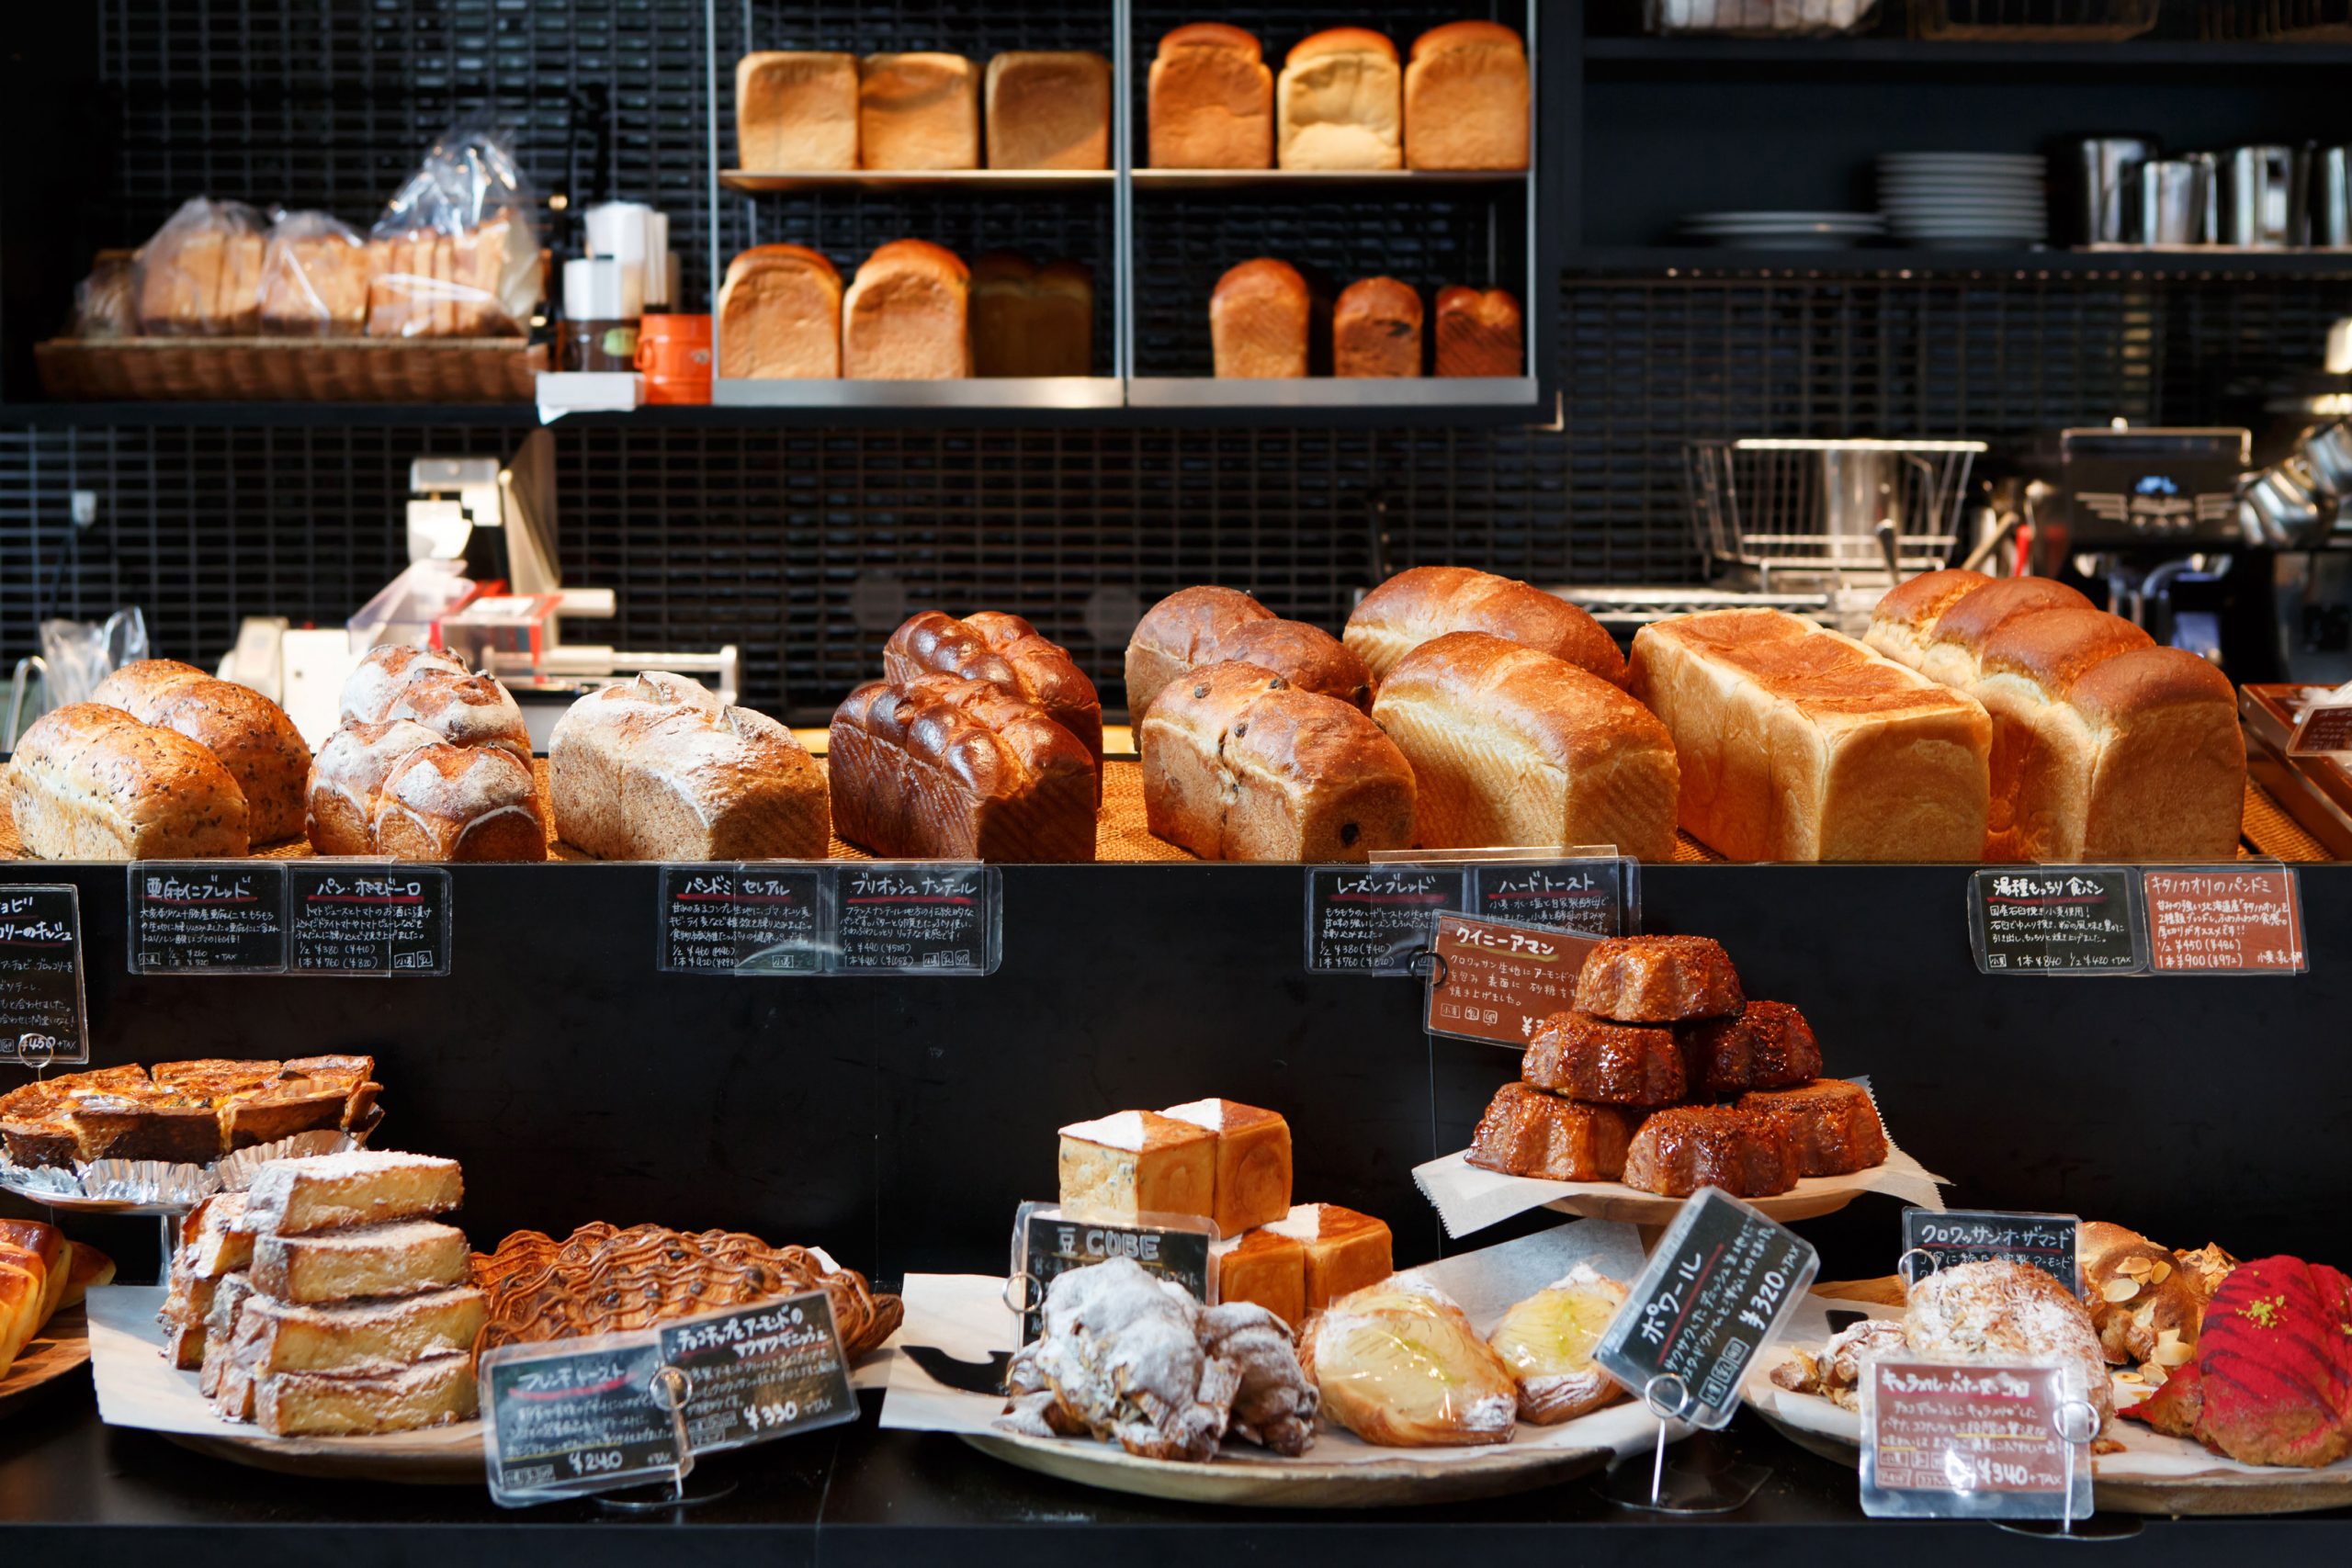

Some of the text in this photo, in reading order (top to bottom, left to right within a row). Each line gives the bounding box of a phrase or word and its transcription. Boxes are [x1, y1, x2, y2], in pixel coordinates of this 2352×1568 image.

[145, 874, 251, 899] 亜麻仁ブレッド
[684, 874, 791, 897] パンドミ セレアル
[851, 872, 978, 897] ブリオッシュ ナンテール
[1498, 870, 1596, 893] ハードトースト
[2150, 875, 2272, 897] キタノカオリのパンドミ
[0, 896, 34, 914] ョビ
[314, 943, 339, 955] ¥380
[1334, 943, 1359, 956] ¥380
[1455, 926, 1555, 956] クイニーアマン
[2175, 939, 2203, 953] ¥450
[2205, 938, 2242, 953] (¥486)
[1335, 957, 1359, 968] ¥760
[2035, 955, 2063, 966] ¥840
[2176, 953, 2206, 969] ¥900
[1641, 1252, 1702, 1346] ポワール
[1738, 1269, 1786, 1332] ¥320
[568, 1450, 623, 1476] ¥240
[1977, 1457, 2029, 1486] ¥340
